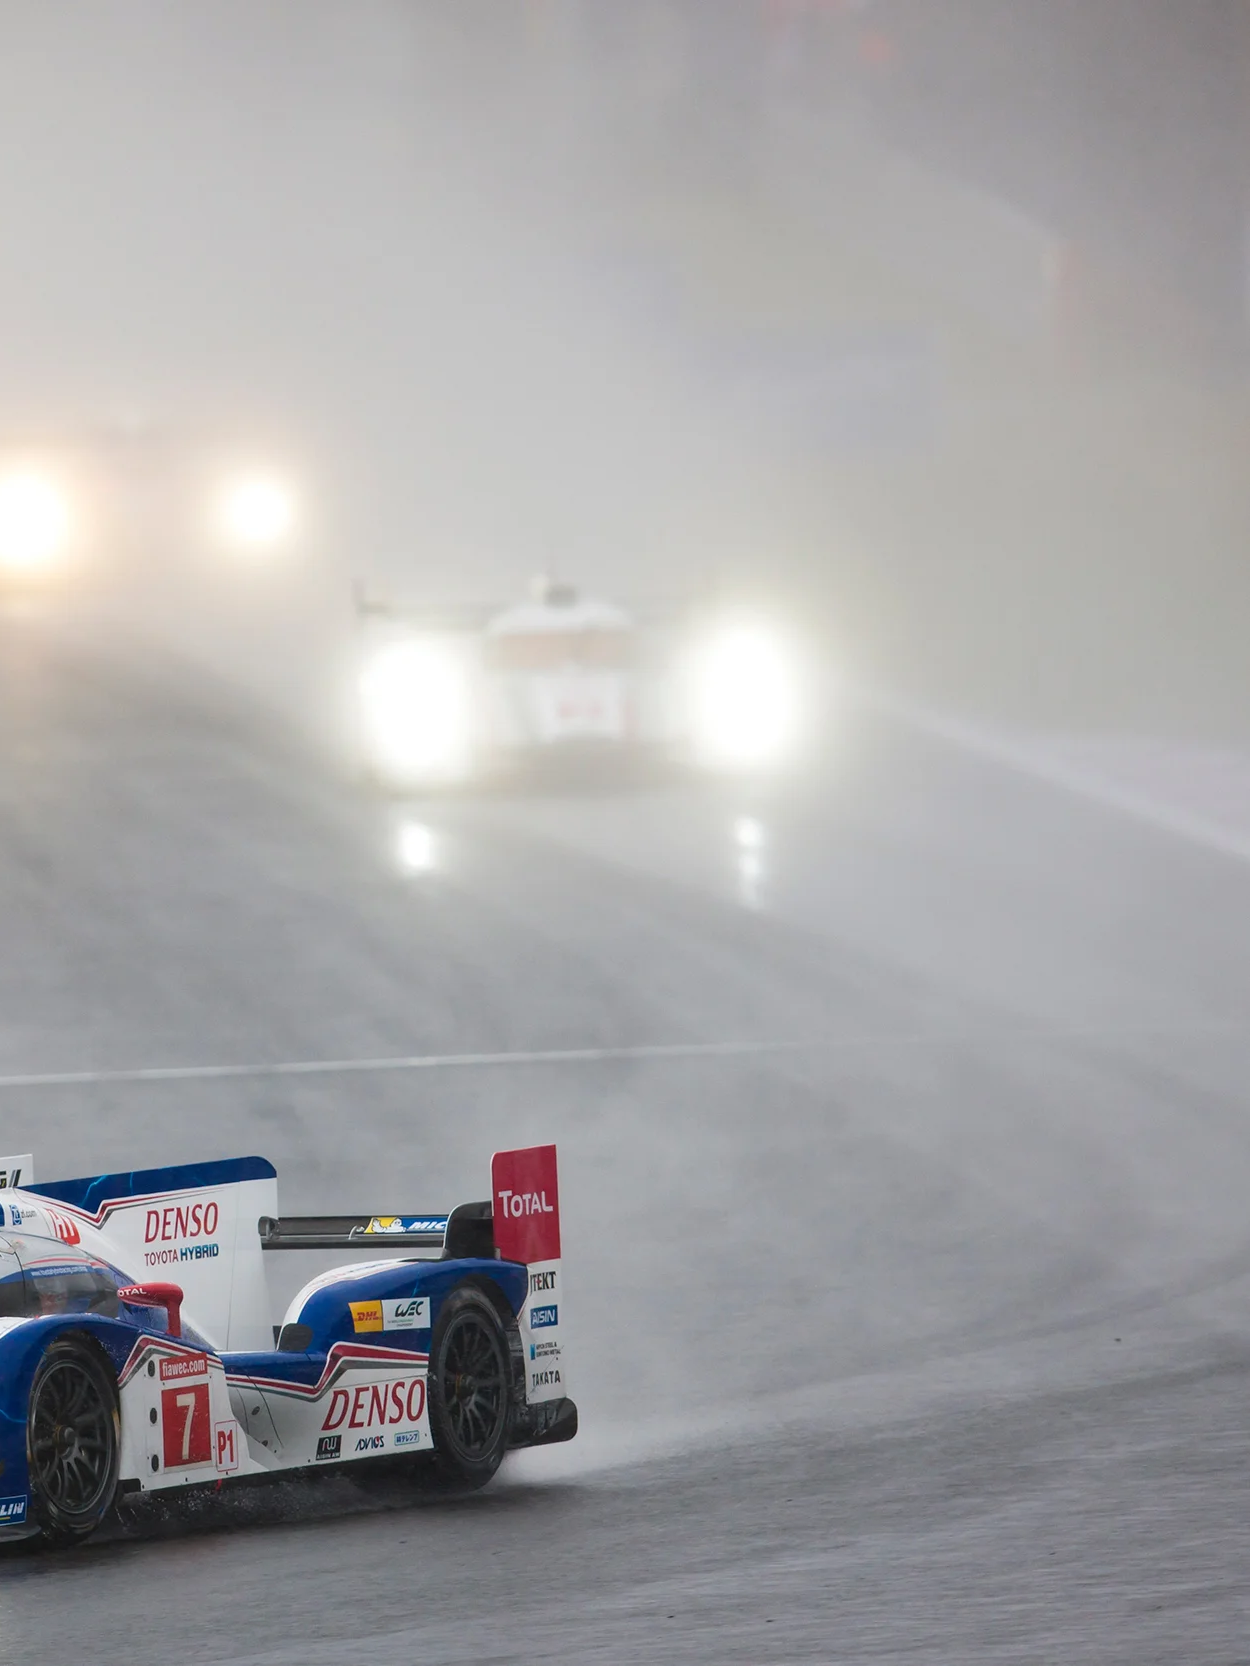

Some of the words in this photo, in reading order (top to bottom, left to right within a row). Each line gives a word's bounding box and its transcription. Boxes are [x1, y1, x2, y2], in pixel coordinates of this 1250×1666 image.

[498, 1190, 553, 1218] TOTAL
[145, 1202, 218, 1243] DENSO
[144, 1249, 179, 1266] TOYOTA
[180, 1243, 219, 1261] HYBRID
[529, 1271, 556, 1297] JTEKT
[356, 1311, 379, 1322] DHL
[395, 1301, 424, 1317] WEC
[532, 1309, 556, 1325] AISIN
[162, 1359, 205, 1376] fiawec.com
[532, 1370, 561, 1387] TAKATA
[321, 1379, 425, 1431] DENSO
[176, 1392, 196, 1460] 7
[217, 1429, 234, 1464] P1
